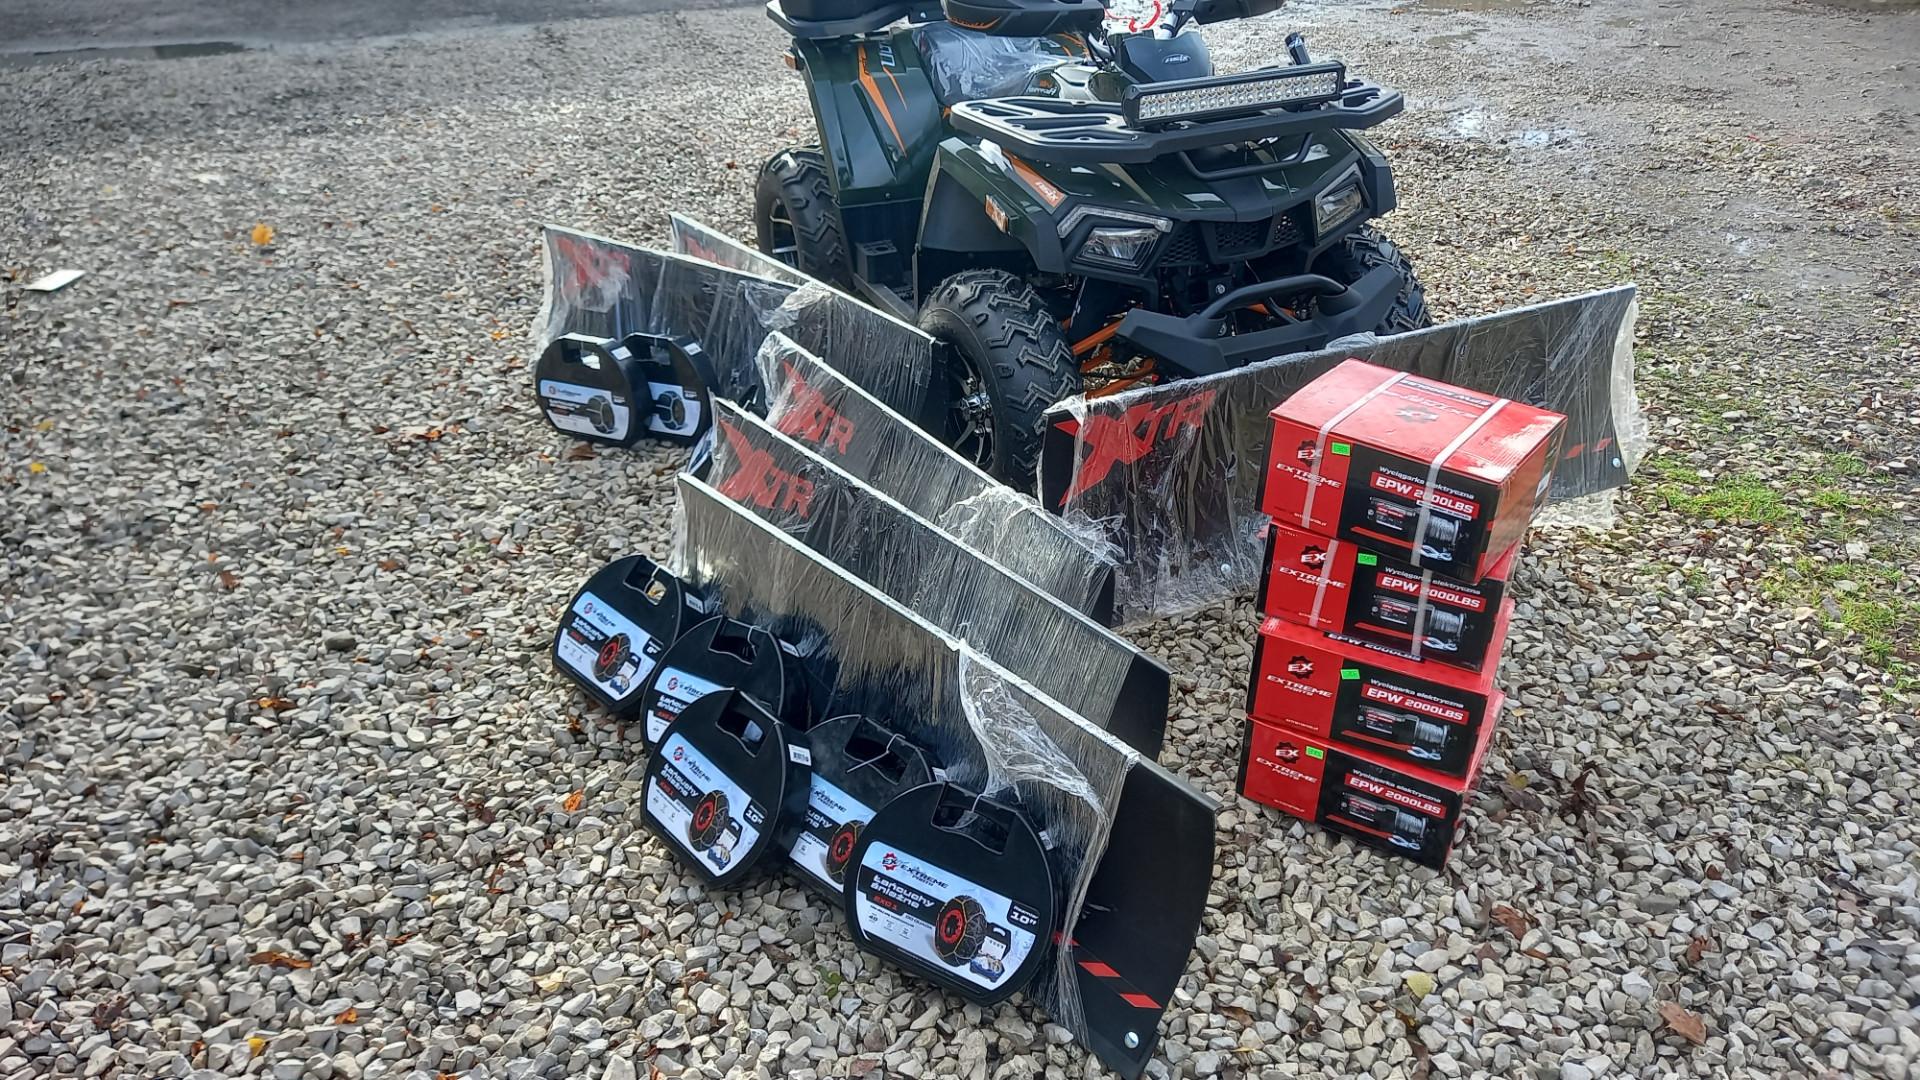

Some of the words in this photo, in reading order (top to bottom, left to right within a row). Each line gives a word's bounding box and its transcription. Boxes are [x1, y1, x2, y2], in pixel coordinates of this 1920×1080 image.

[1375, 476, 1412, 495] EPW
[1413, 489, 1474, 514] 200LBS
[1300, 552, 1327, 564] EX
[1381, 576, 1420, 592] EPW
[1385, 566, 1430, 583] Wyciągar
[1287, 662, 1314, 672] EX
[1266, 674, 1334, 698] EXTREME
[1367, 687, 1403, 704] EPW
[1404, 699, 1464, 721] 2000LBS
[1275, 749, 1300, 758] EX
[1256, 757, 1318, 784] EXTREME
[1350, 777, 1385, 794] EPW
[1385, 790, 1441, 814] 2000LBS
[900, 864, 949, 889] EXTREME
